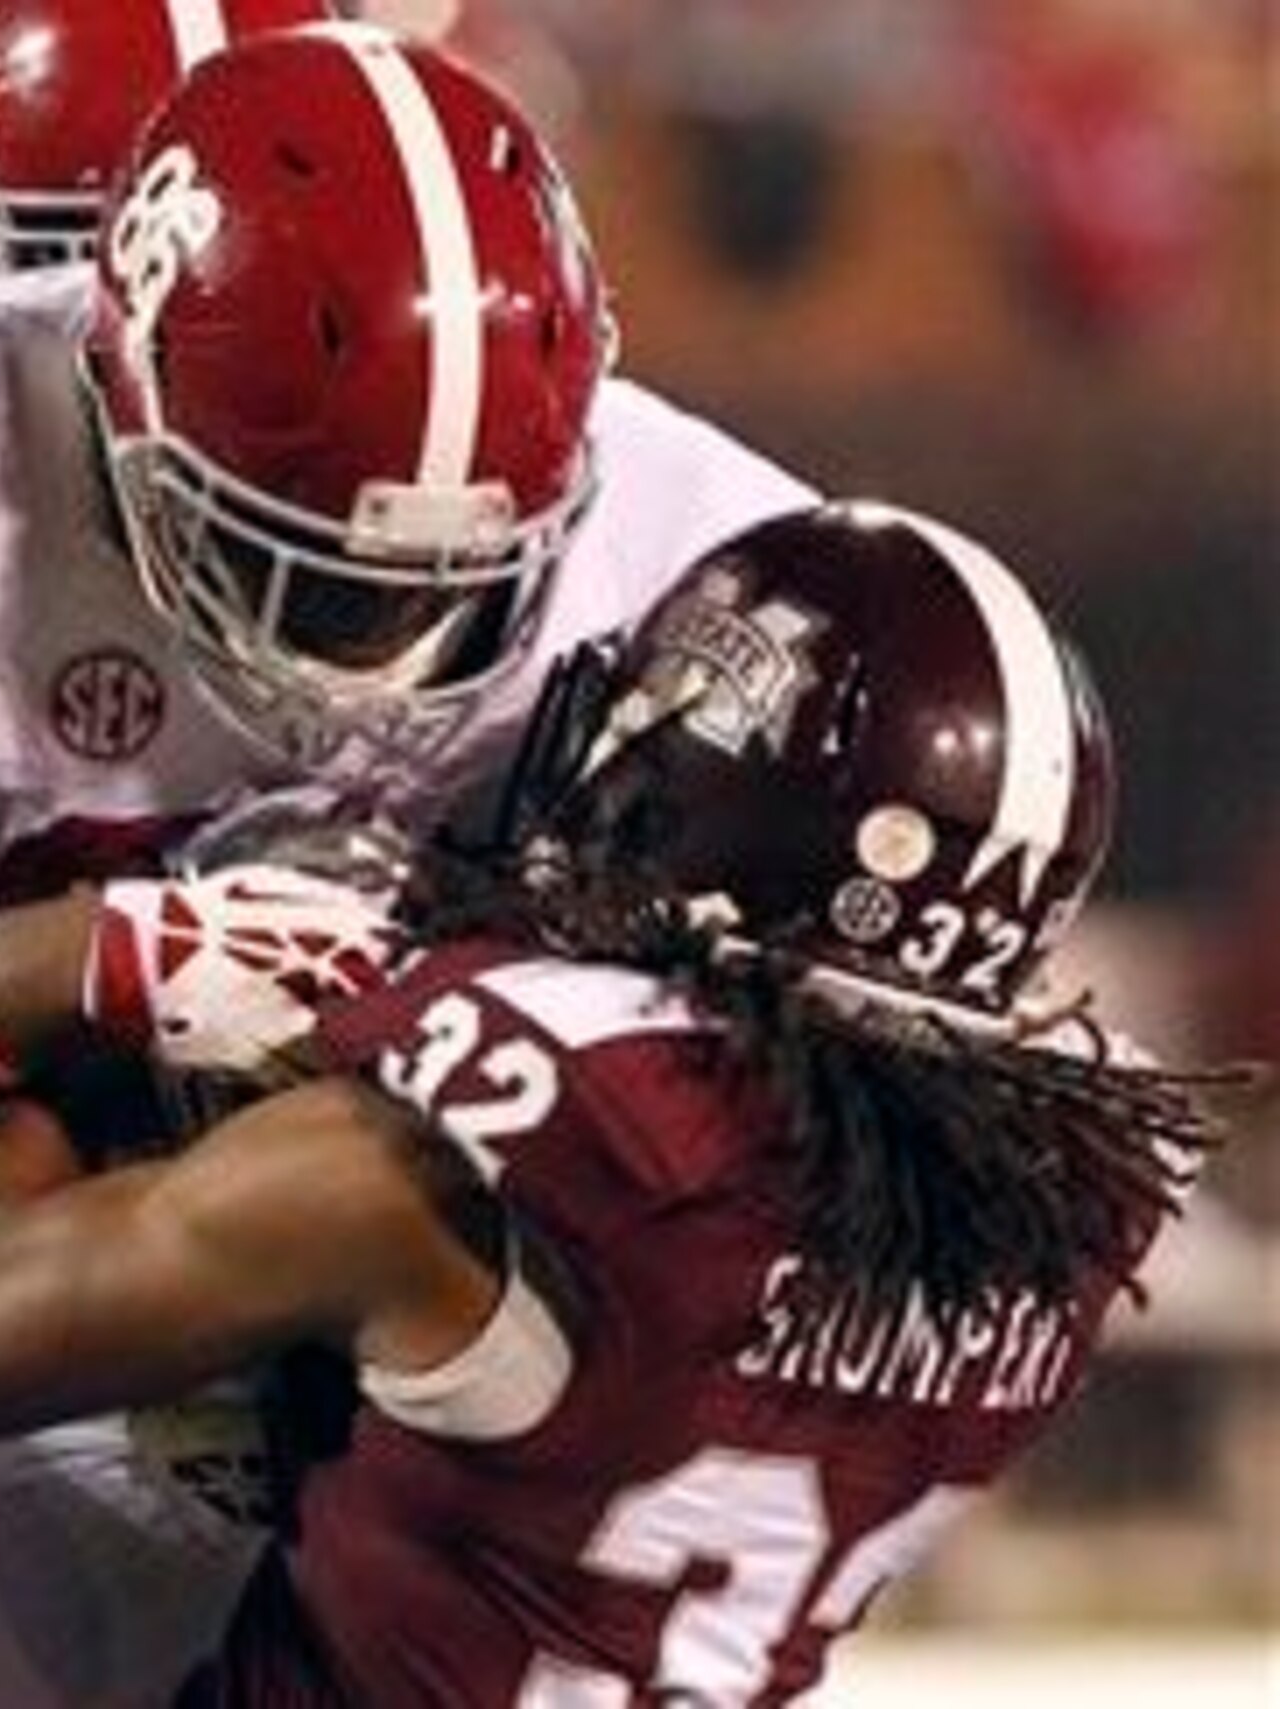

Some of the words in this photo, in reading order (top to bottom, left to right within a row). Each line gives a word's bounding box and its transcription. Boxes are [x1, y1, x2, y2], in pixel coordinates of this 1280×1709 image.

[58, 658, 158, 754] SEC
[900, 903, 1026, 1006] 32
[378, 992, 560, 1188] 32
